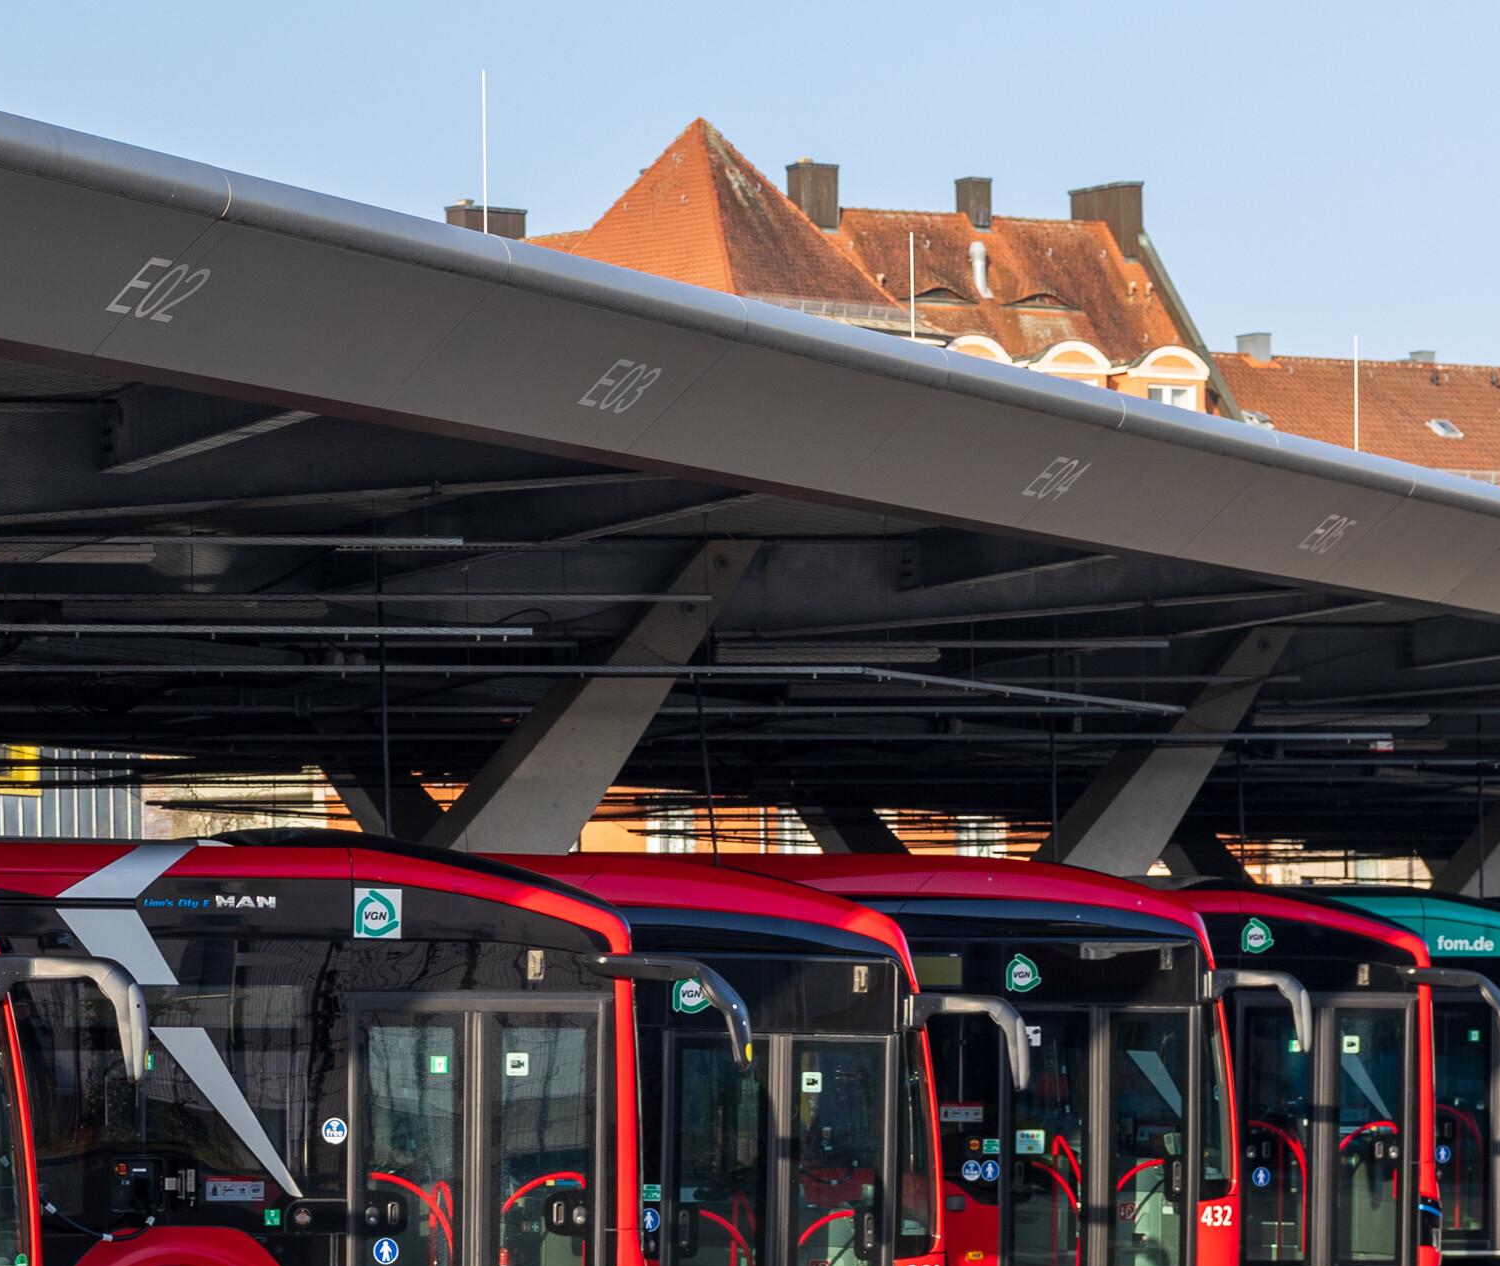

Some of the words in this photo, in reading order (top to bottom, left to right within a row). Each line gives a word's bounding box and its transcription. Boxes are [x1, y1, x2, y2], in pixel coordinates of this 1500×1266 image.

[105, 256, 211, 323] E02
[577, 358, 662, 414] E03
[1021, 456, 1092, 501] E04
[1297, 514, 1358, 554] E05
[142, 898, 174, 908] Lion's
[177, 898, 200, 909] City
[203, 899, 212, 908] E
[215, 894, 277, 909] MAN
[364, 911, 388, 921] VGN
[1437, 935, 1495, 952] fom.de
[1013, 971, 1031, 979] VGN
[681, 989, 702, 998] VGN
[1200, 1204, 1233, 1227] 432
